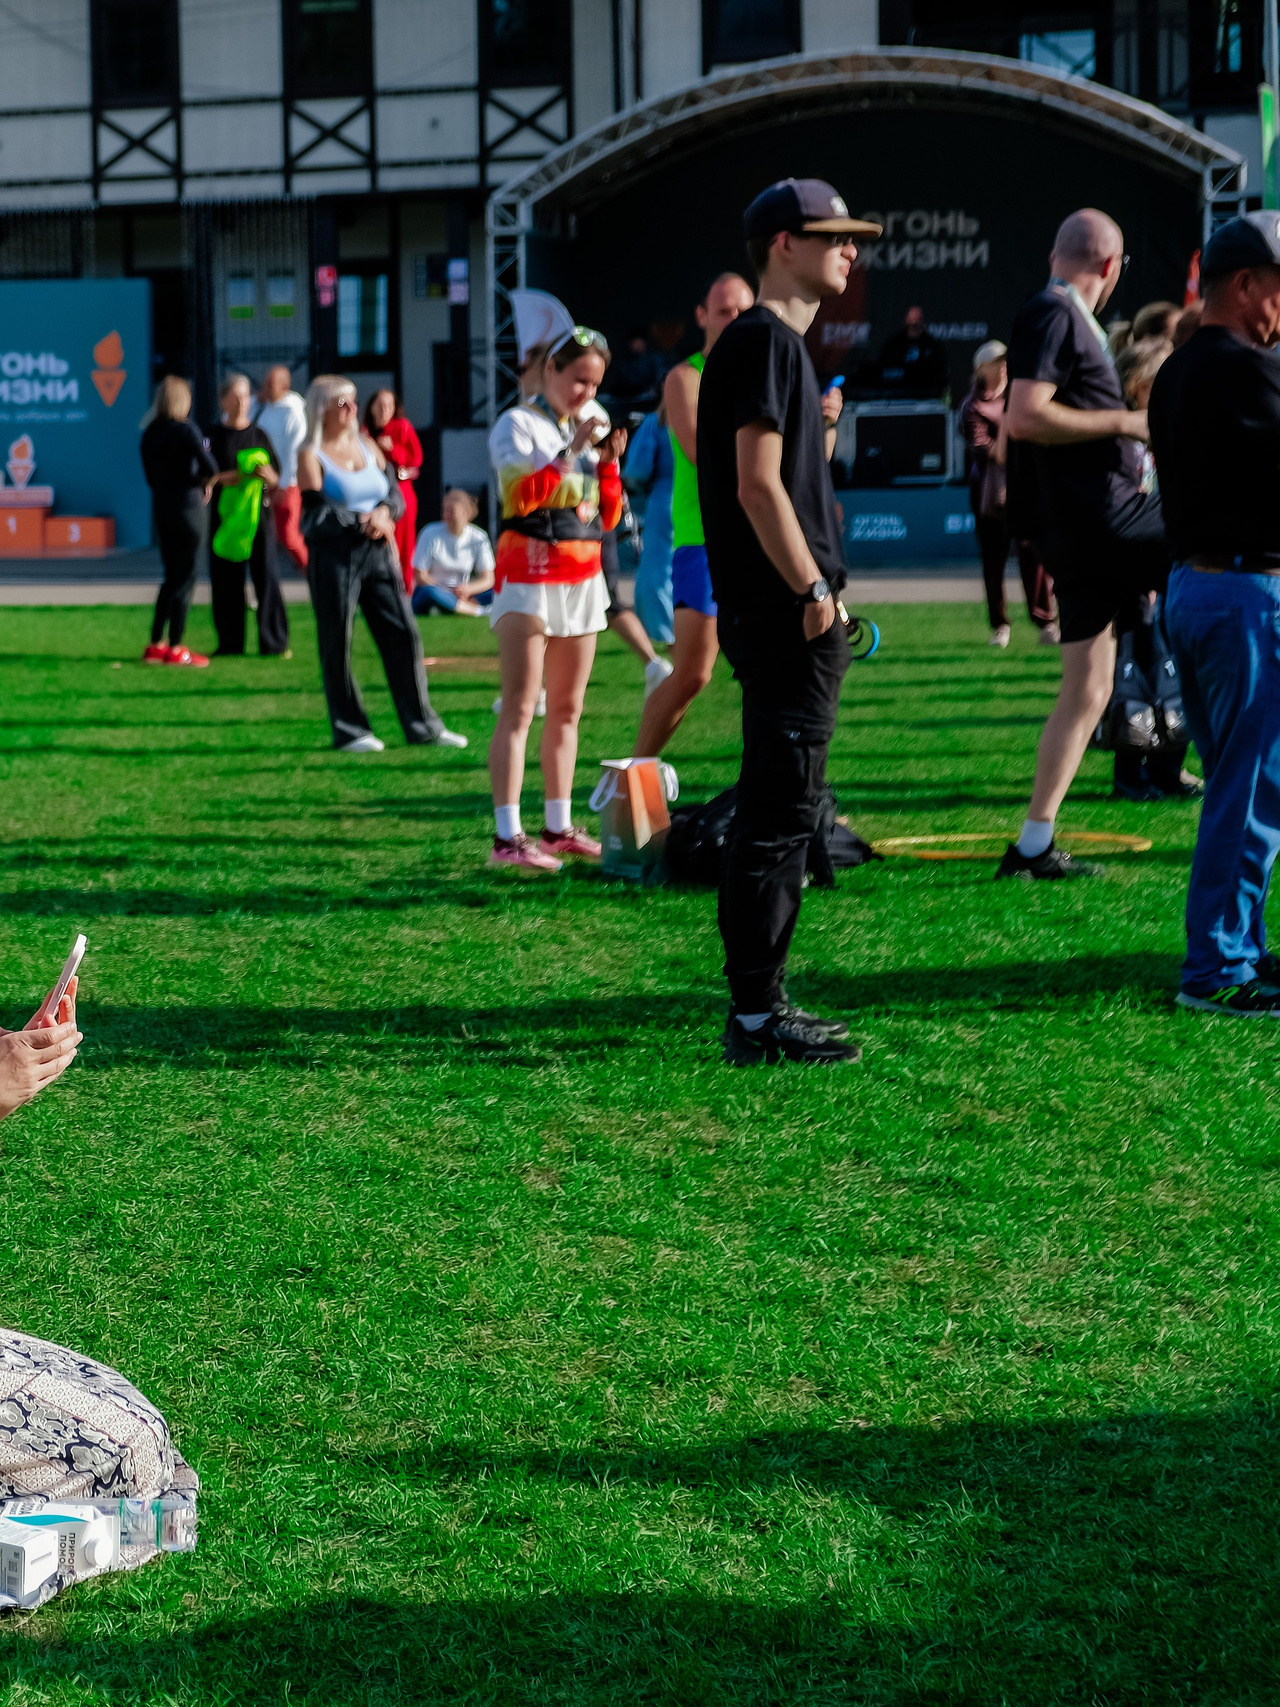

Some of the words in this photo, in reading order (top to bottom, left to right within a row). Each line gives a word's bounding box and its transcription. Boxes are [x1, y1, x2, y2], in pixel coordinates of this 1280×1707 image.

[7, 516, 18, 535] 1
[68, 524, 81, 543] 3
[59, 1534, 67, 1565] ПОМО
